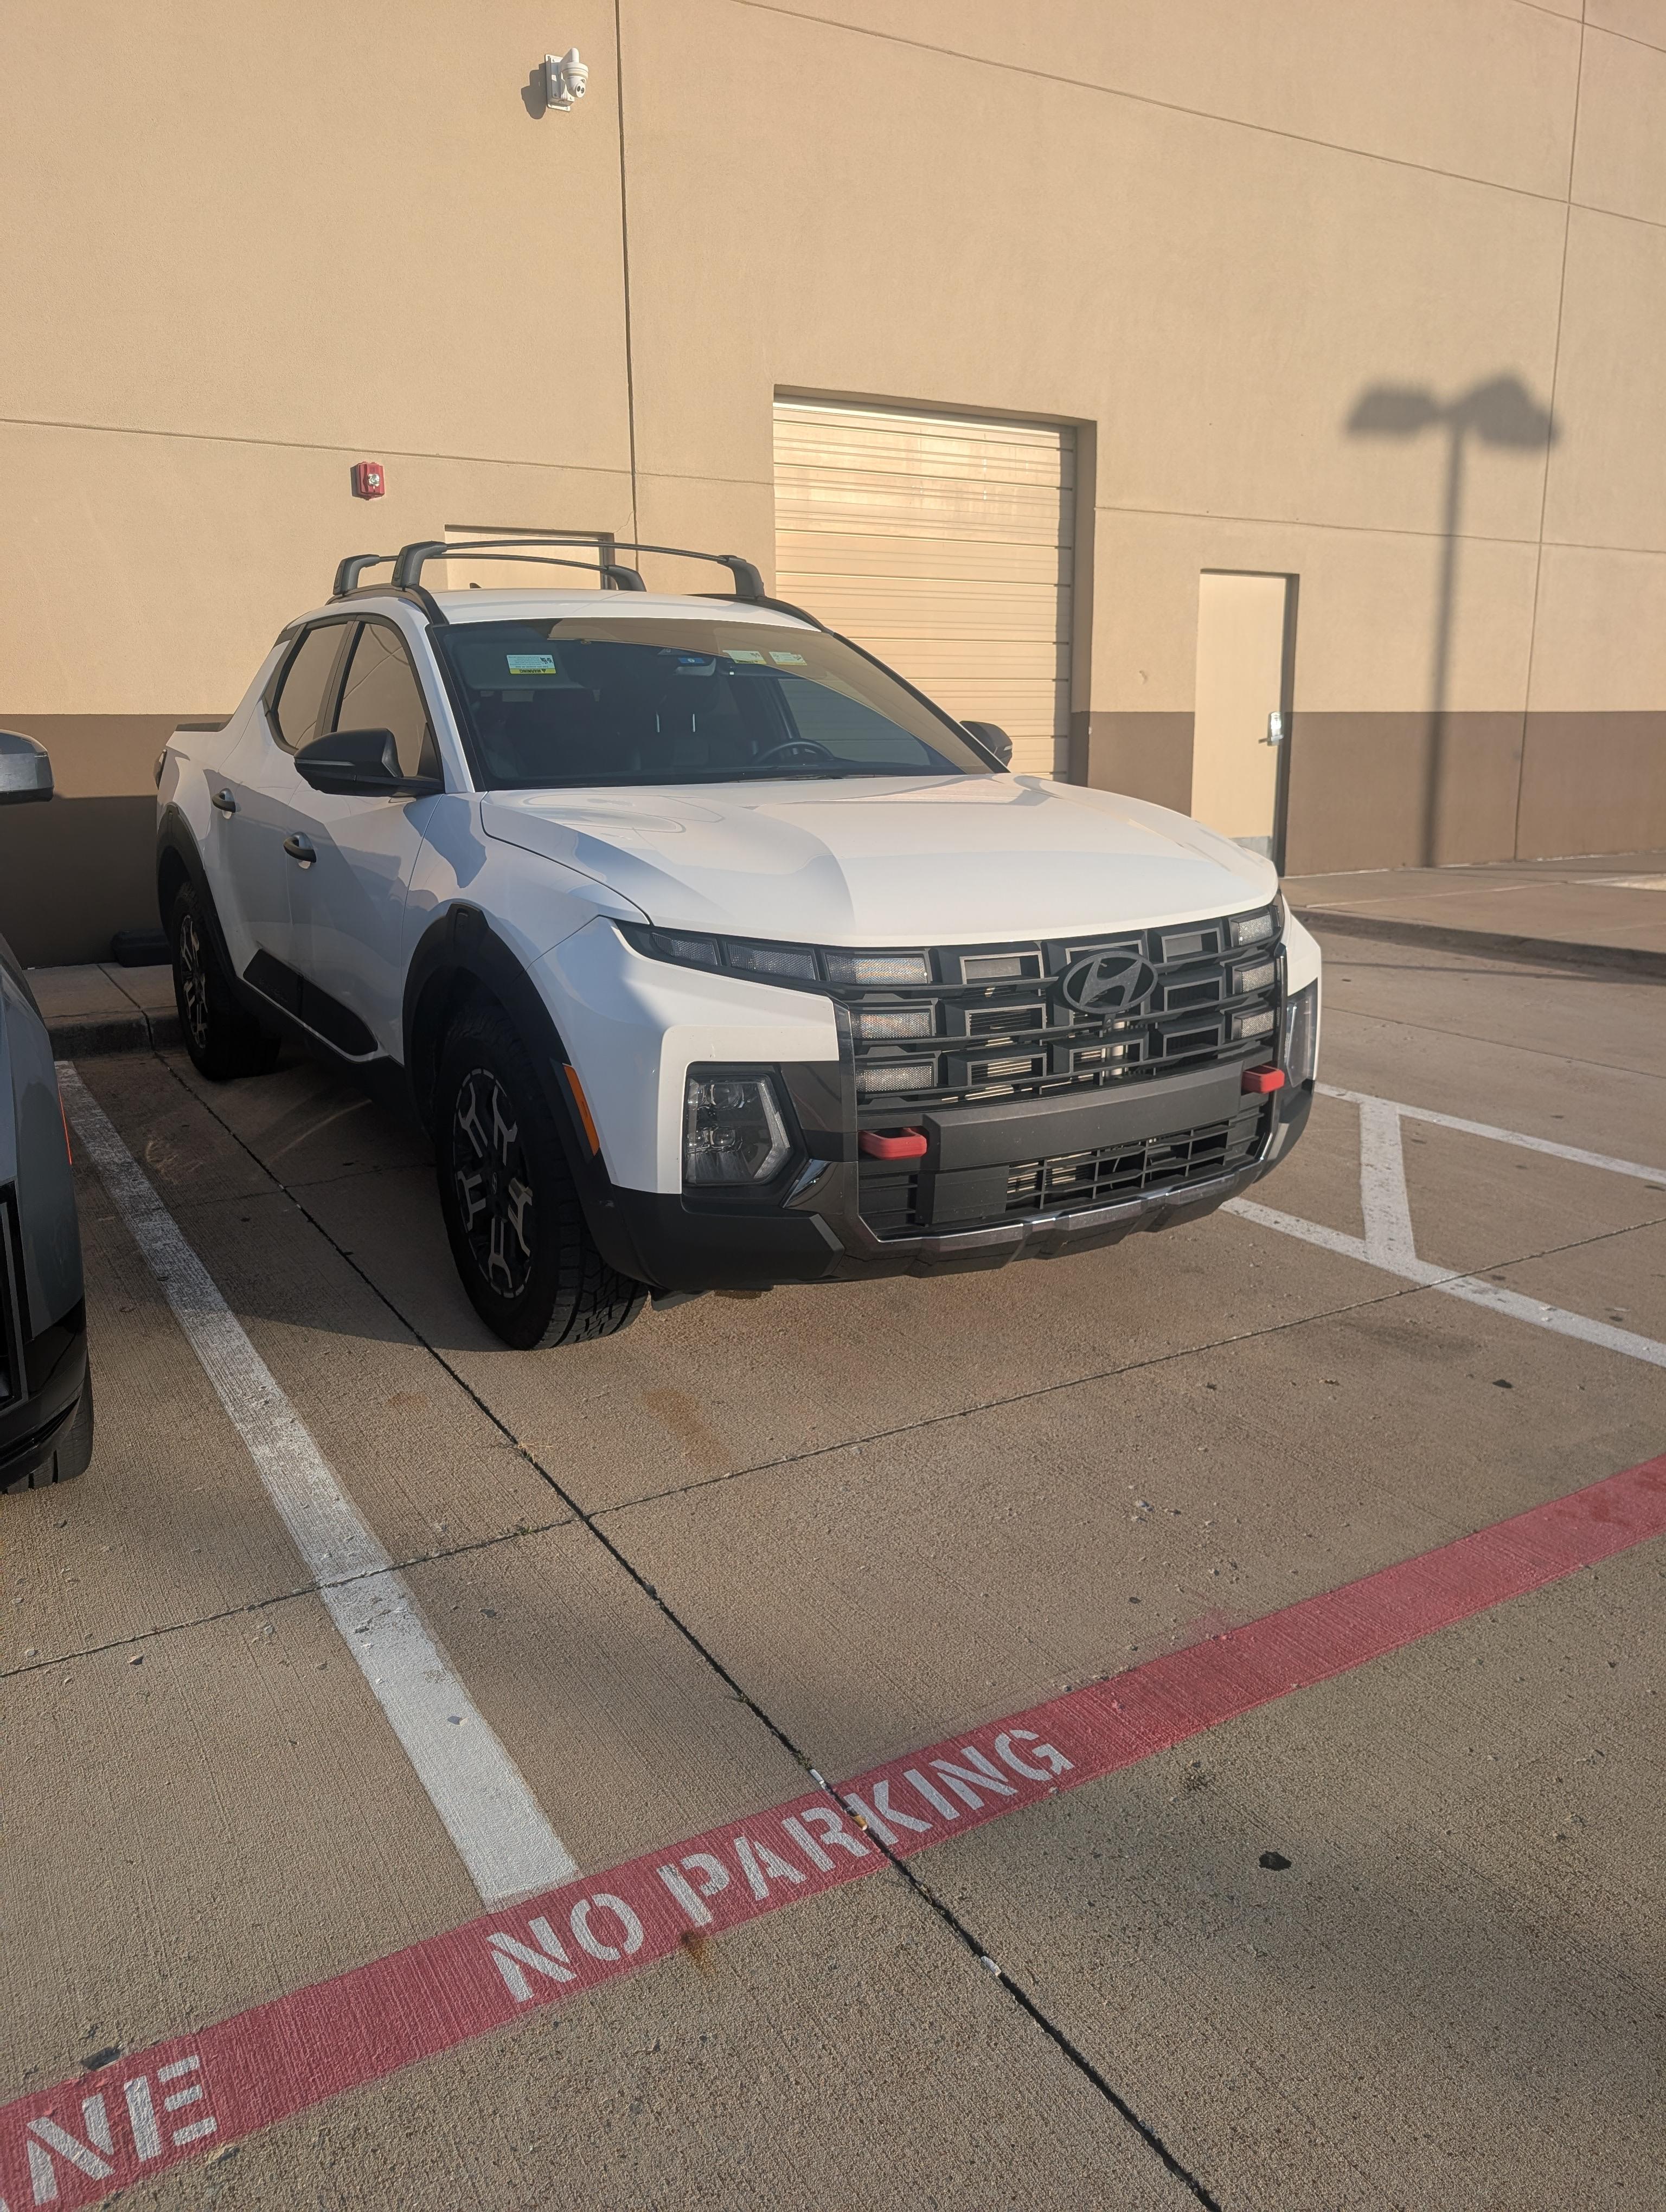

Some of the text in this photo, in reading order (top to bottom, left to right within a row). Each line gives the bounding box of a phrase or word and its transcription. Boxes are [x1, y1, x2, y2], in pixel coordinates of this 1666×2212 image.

[486, 1729, 1074, 2003] NO PARKING
[0, 2054, 217, 2212] NE
